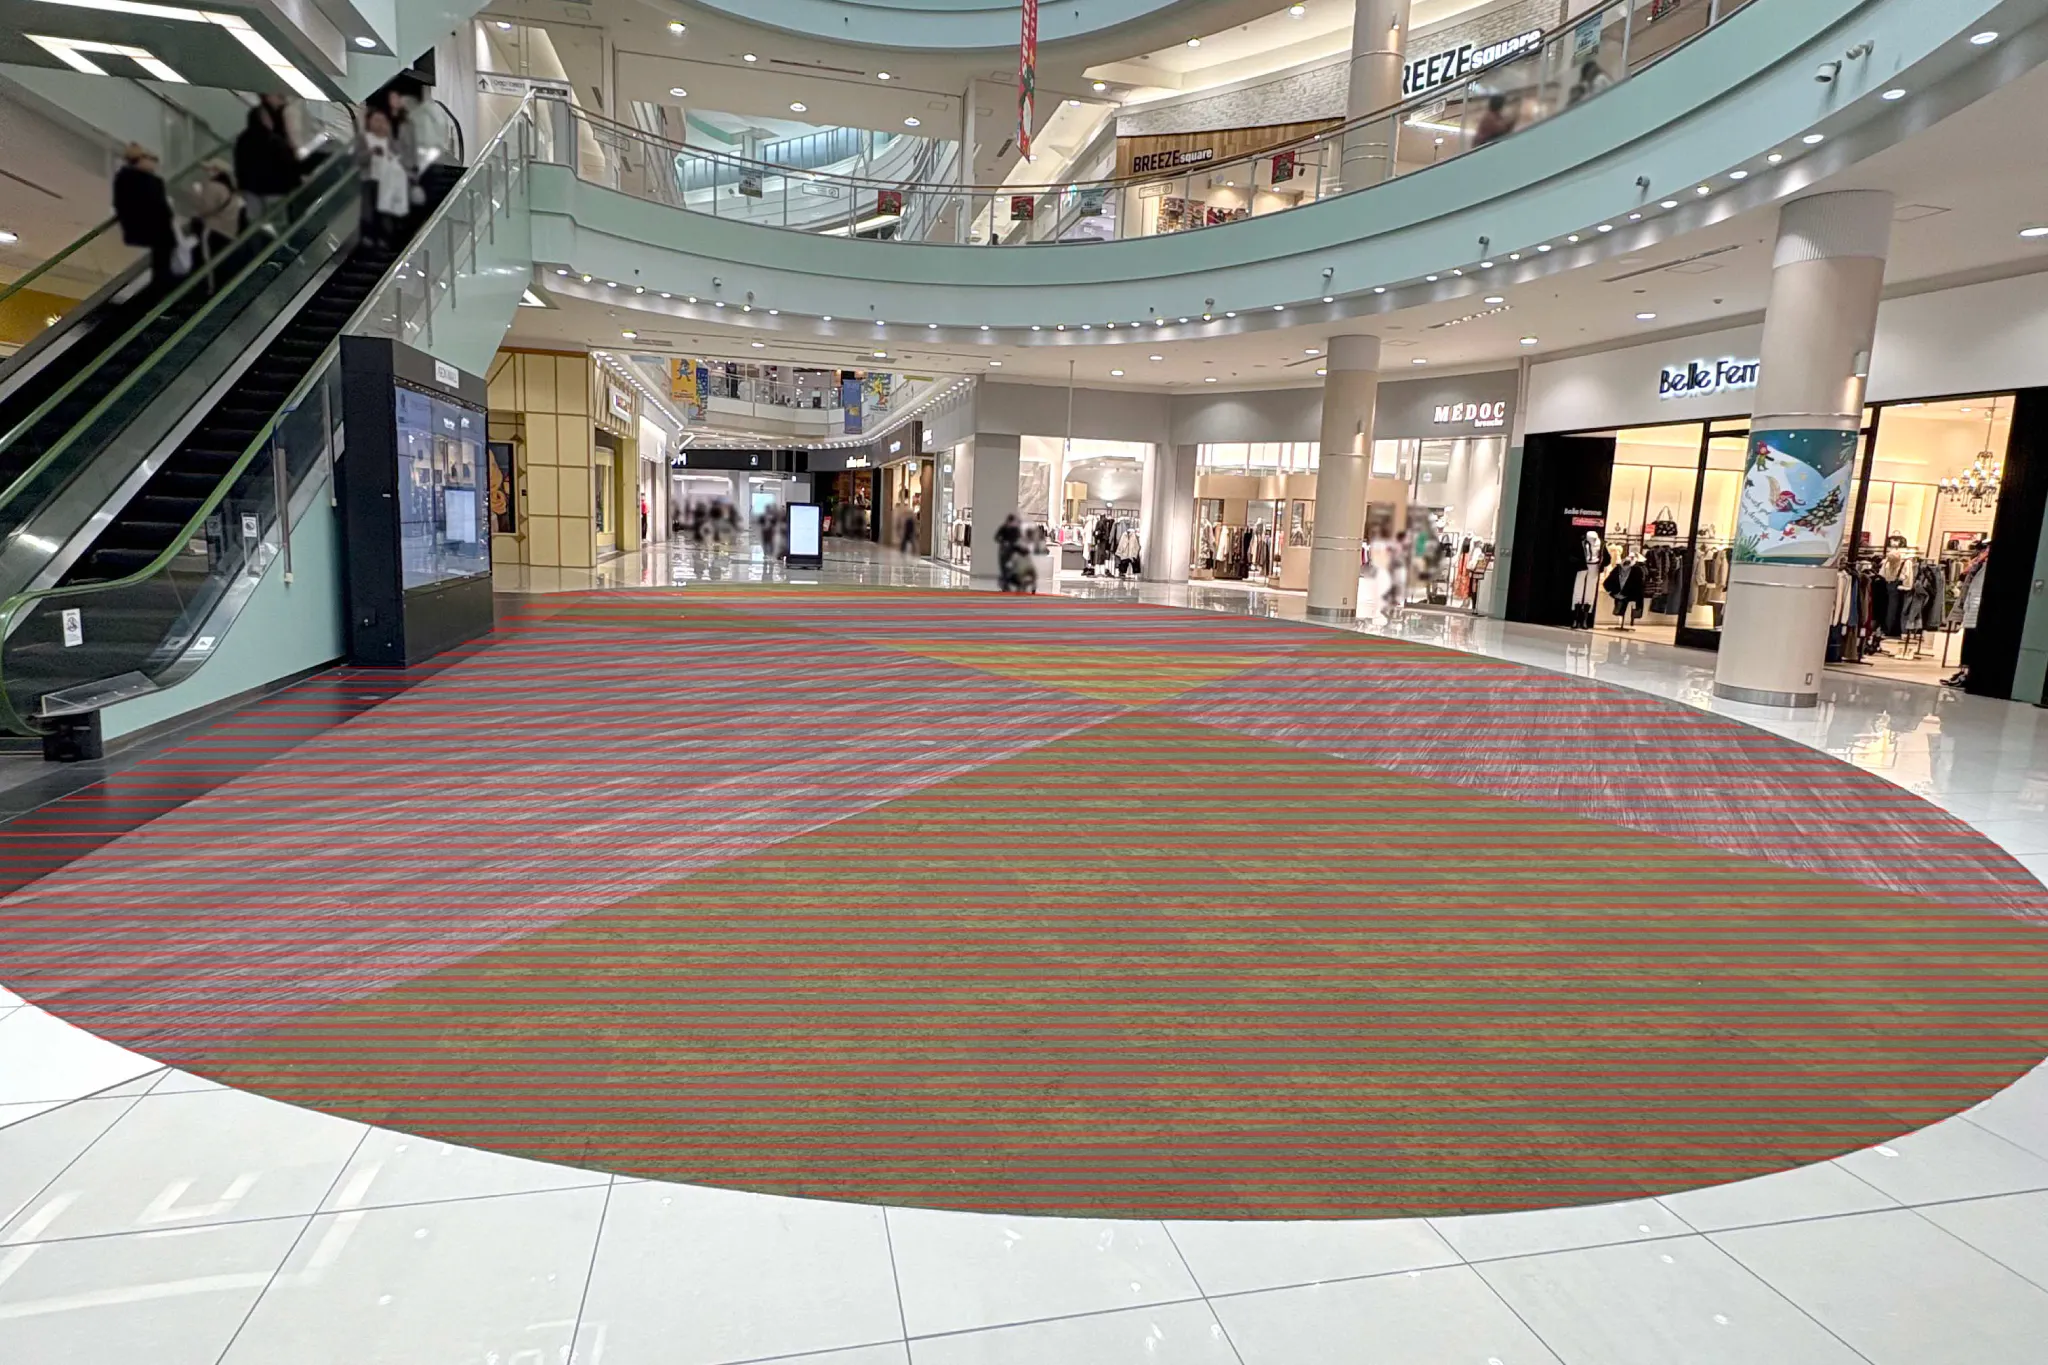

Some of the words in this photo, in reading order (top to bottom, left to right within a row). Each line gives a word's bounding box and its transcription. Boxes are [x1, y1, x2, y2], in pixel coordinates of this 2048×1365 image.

[1403, 43, 1473, 95] REEZE
[1133, 150, 1180, 173] BREEZE
[1659, 363, 1711, 394] Belle
[1715, 360, 1760, 387] Fem
